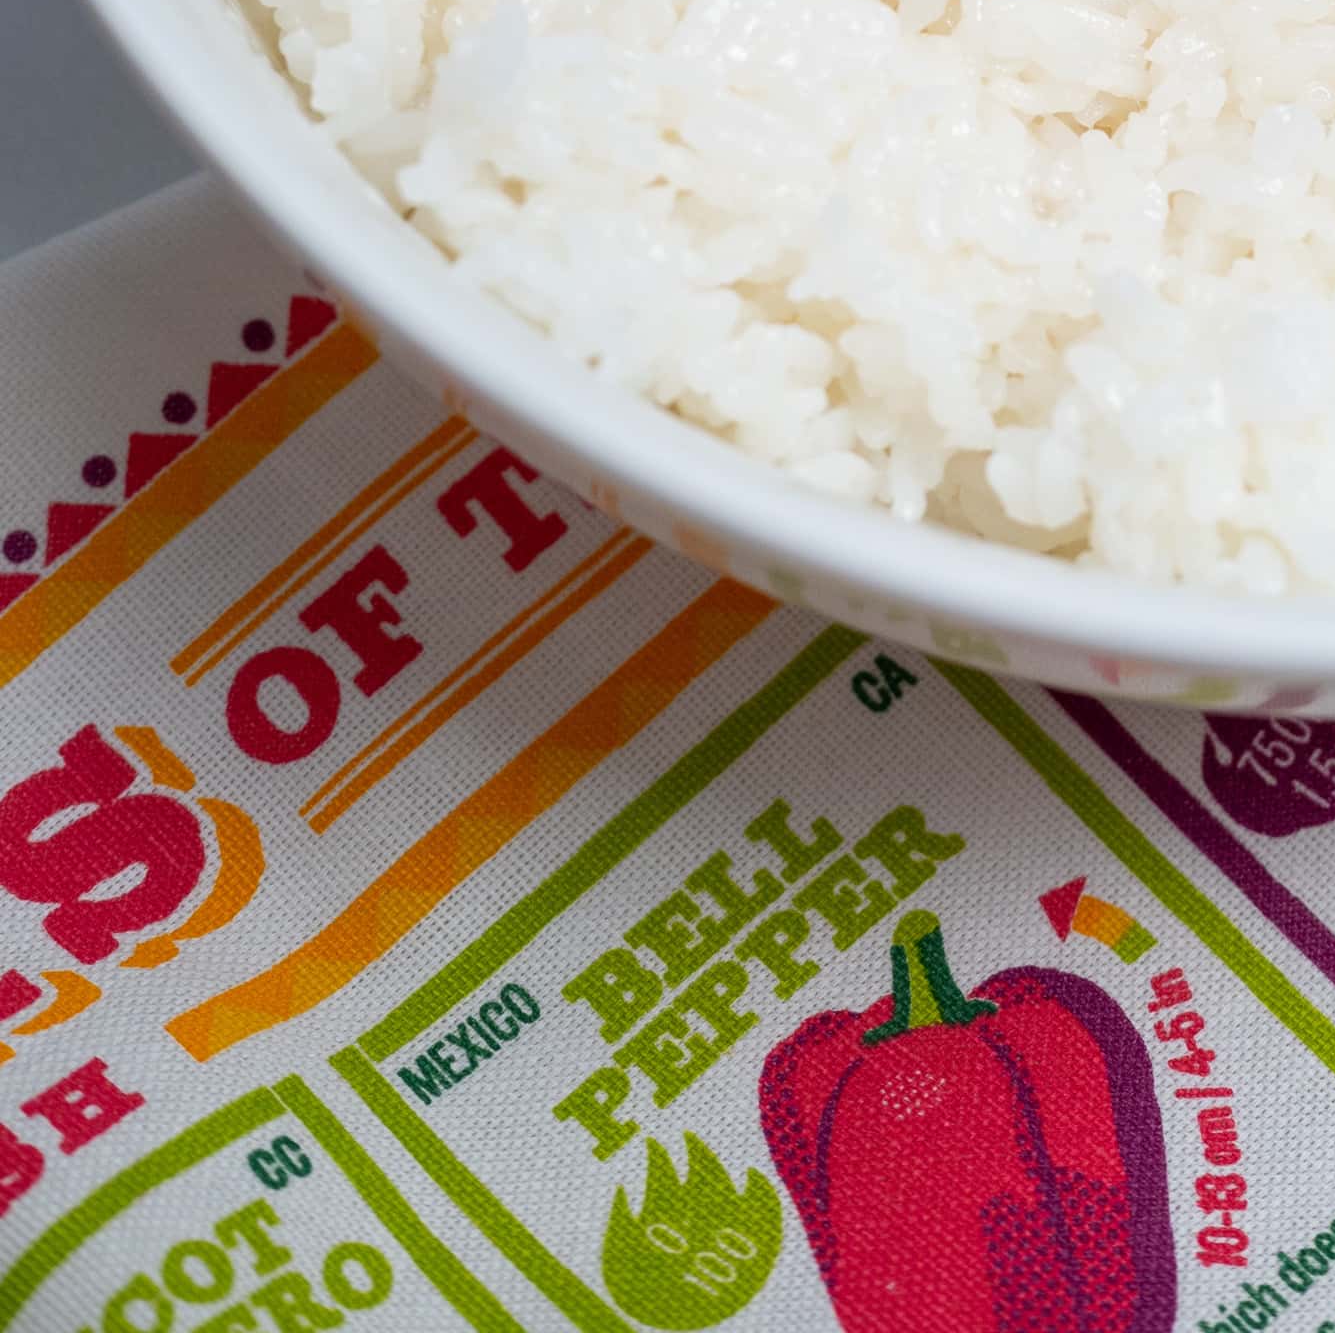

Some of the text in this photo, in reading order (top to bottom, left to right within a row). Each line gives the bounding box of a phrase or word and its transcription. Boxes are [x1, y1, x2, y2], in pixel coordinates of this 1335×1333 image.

[225, 545, 423, 765] OF
[852, 653, 917, 712] CA
[561, 798, 844, 1044] BELL
[553, 805, 965, 1161] PEPPER
[397, 983, 541, 1105] MEXICO
[248, 1135, 312, 1190] CC
[1196, 1105, 1242, 1167] cm
[77, 1199, 292, 1333] COT
[647, 1223, 688, 1254] 0
[683, 1227, 757, 1296] 100
